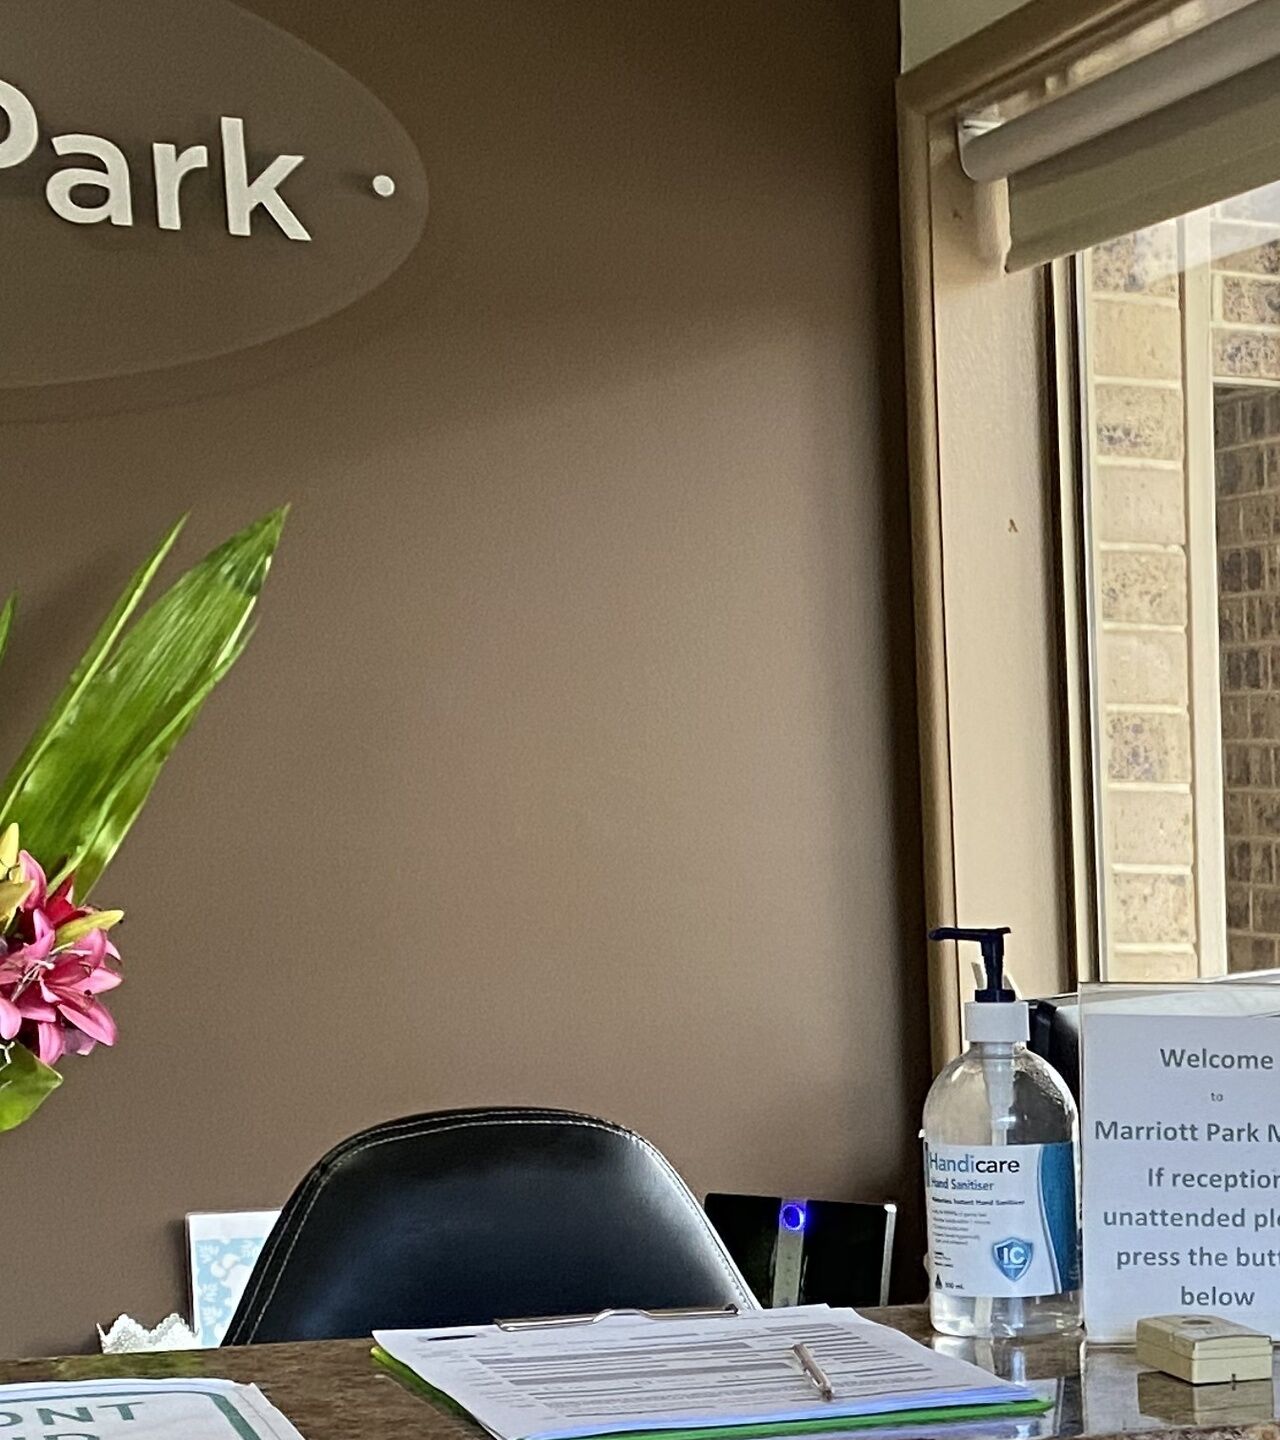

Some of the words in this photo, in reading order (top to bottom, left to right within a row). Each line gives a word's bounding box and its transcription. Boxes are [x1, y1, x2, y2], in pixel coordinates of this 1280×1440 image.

[1160, 1048, 1274, 1070] Welcome
[1211, 1092, 1223, 1102] to
[1094, 1120, 1198, 1141] Marriott
[1207, 1123, 1260, 1142] Park
[929, 1153, 1020, 1173] Handicare
[951, 1179, 994, 1190] Sanitiser
[1148, 1168, 1164, 1187] If
[1104, 1208, 1246, 1228] unattended
[1004, 1247, 1025, 1263] IC
[1116, 1250, 1180, 1270] press
[1189, 1247, 1228, 1267] the
[1181, 1286, 1255, 1306] below
